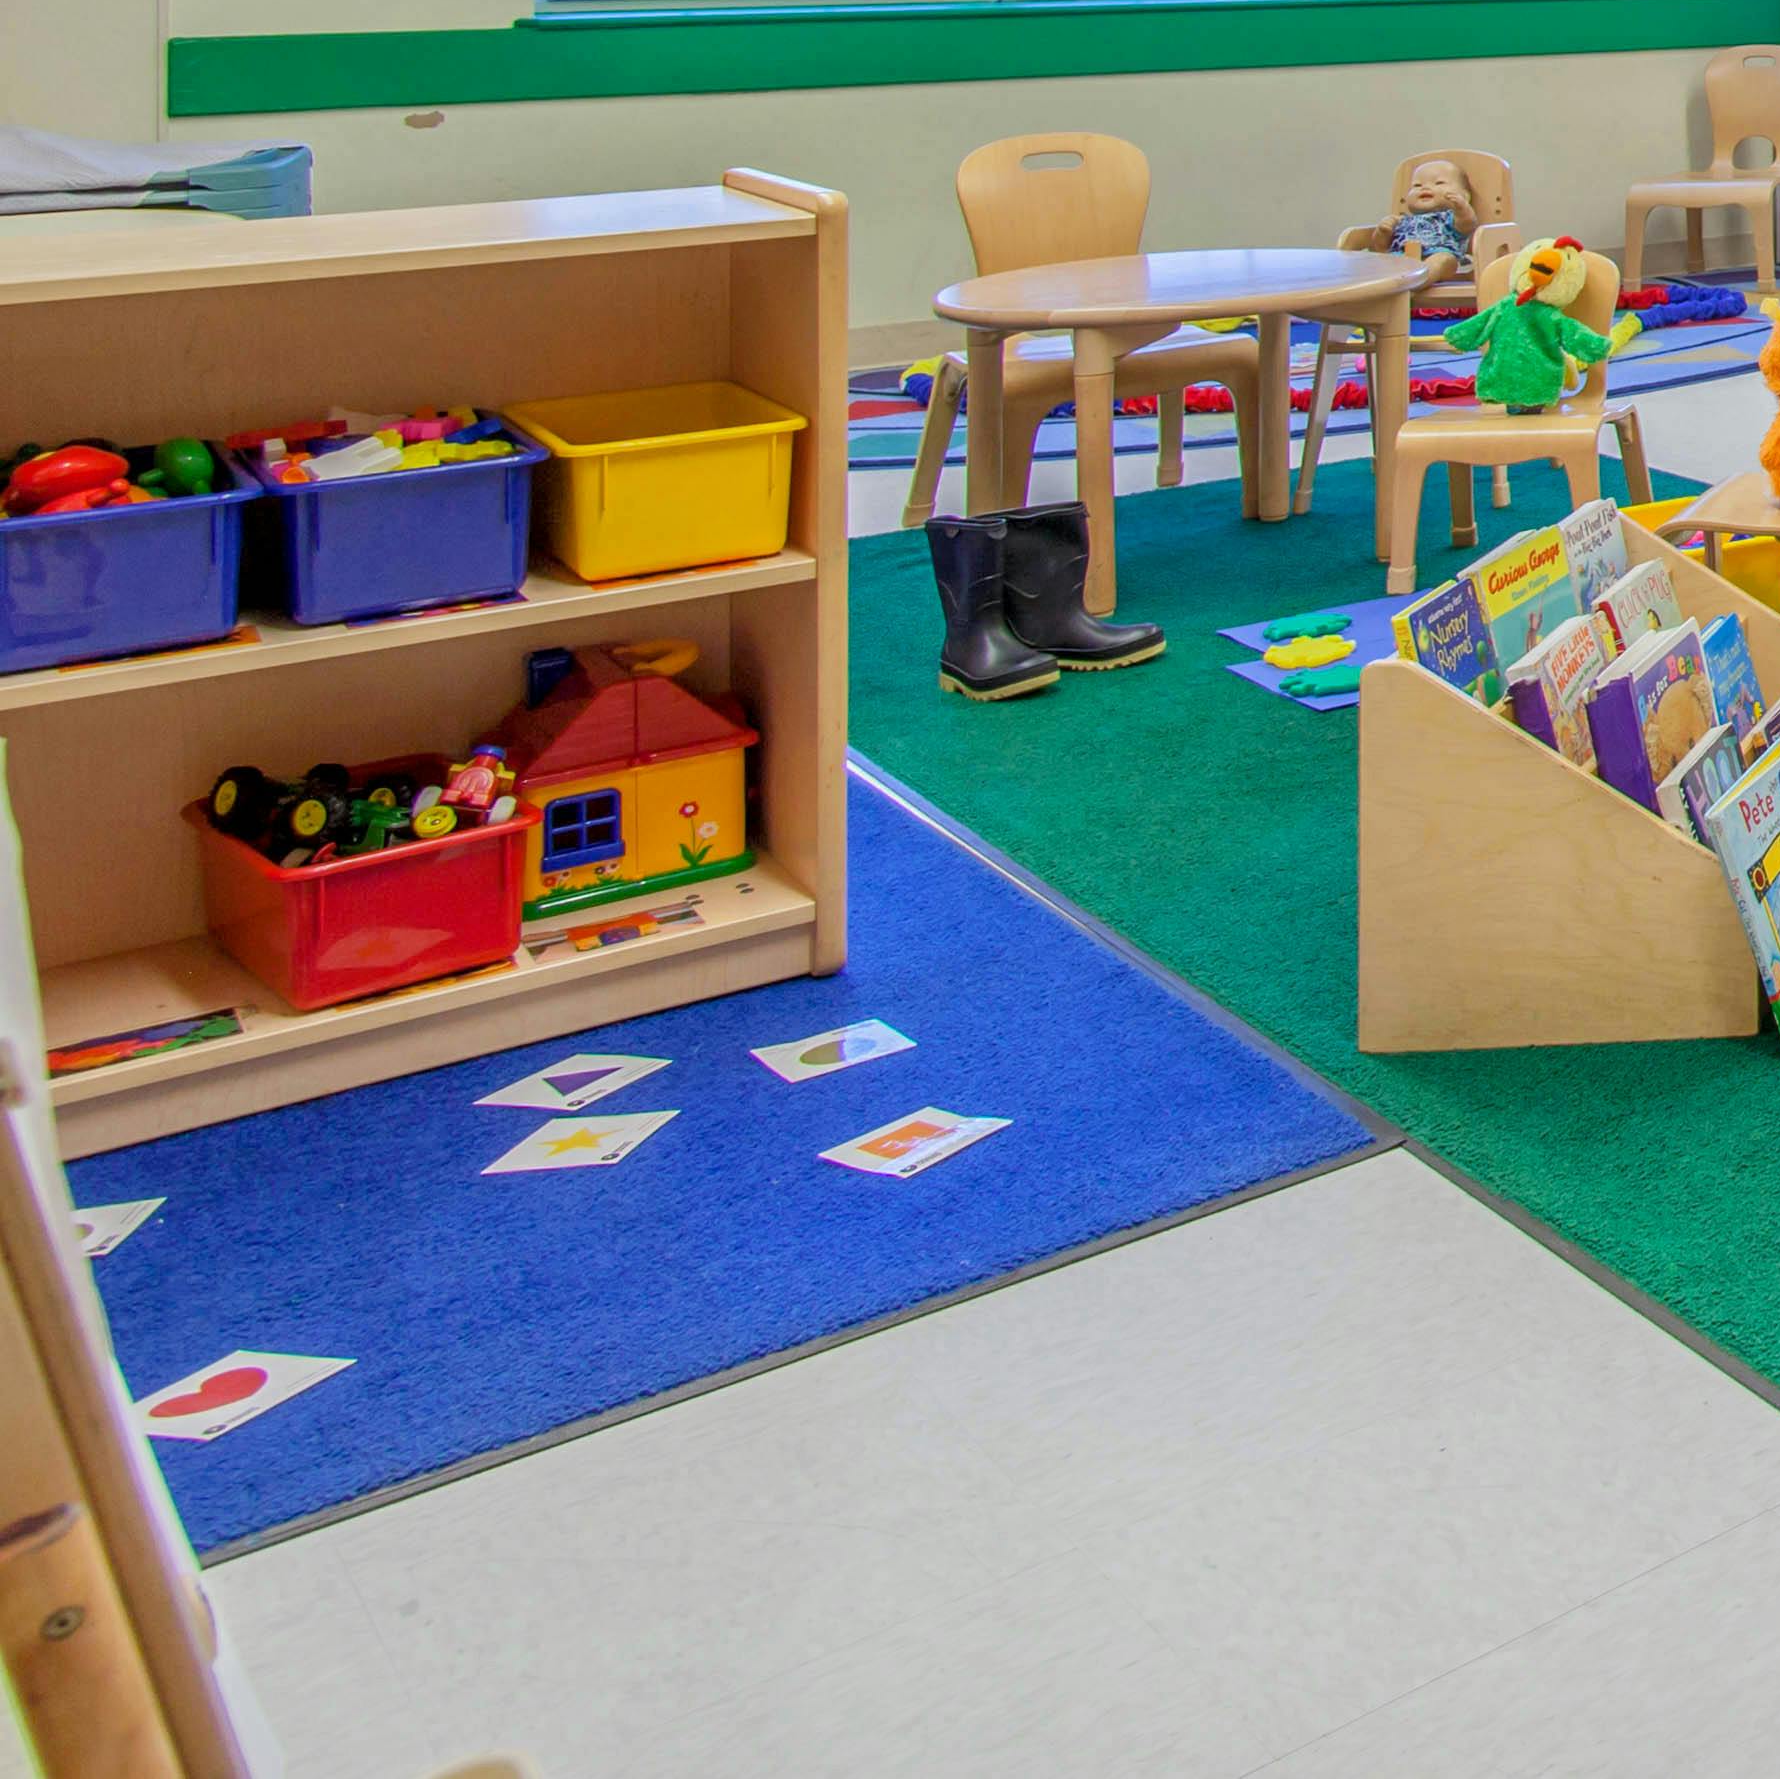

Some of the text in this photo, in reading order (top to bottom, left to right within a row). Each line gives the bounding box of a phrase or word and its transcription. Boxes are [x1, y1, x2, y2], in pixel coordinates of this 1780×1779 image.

[1488, 563, 1528, 594] Curious
[1529, 542, 1560, 571] George
[1430, 610, 1469, 653] Nursery
[1436, 635, 1473, 677] Rhymes
[1551, 644, 1568, 678] FIVE
[1557, 637, 1596, 694] MONKEYS
[1648, 691, 1657, 708] is
[1656, 675, 1668, 696] for
[1666, 653, 1702, 682] Bear
[1686, 734, 1743, 840] HOOT
[1738, 792, 1775, 834] Pete
